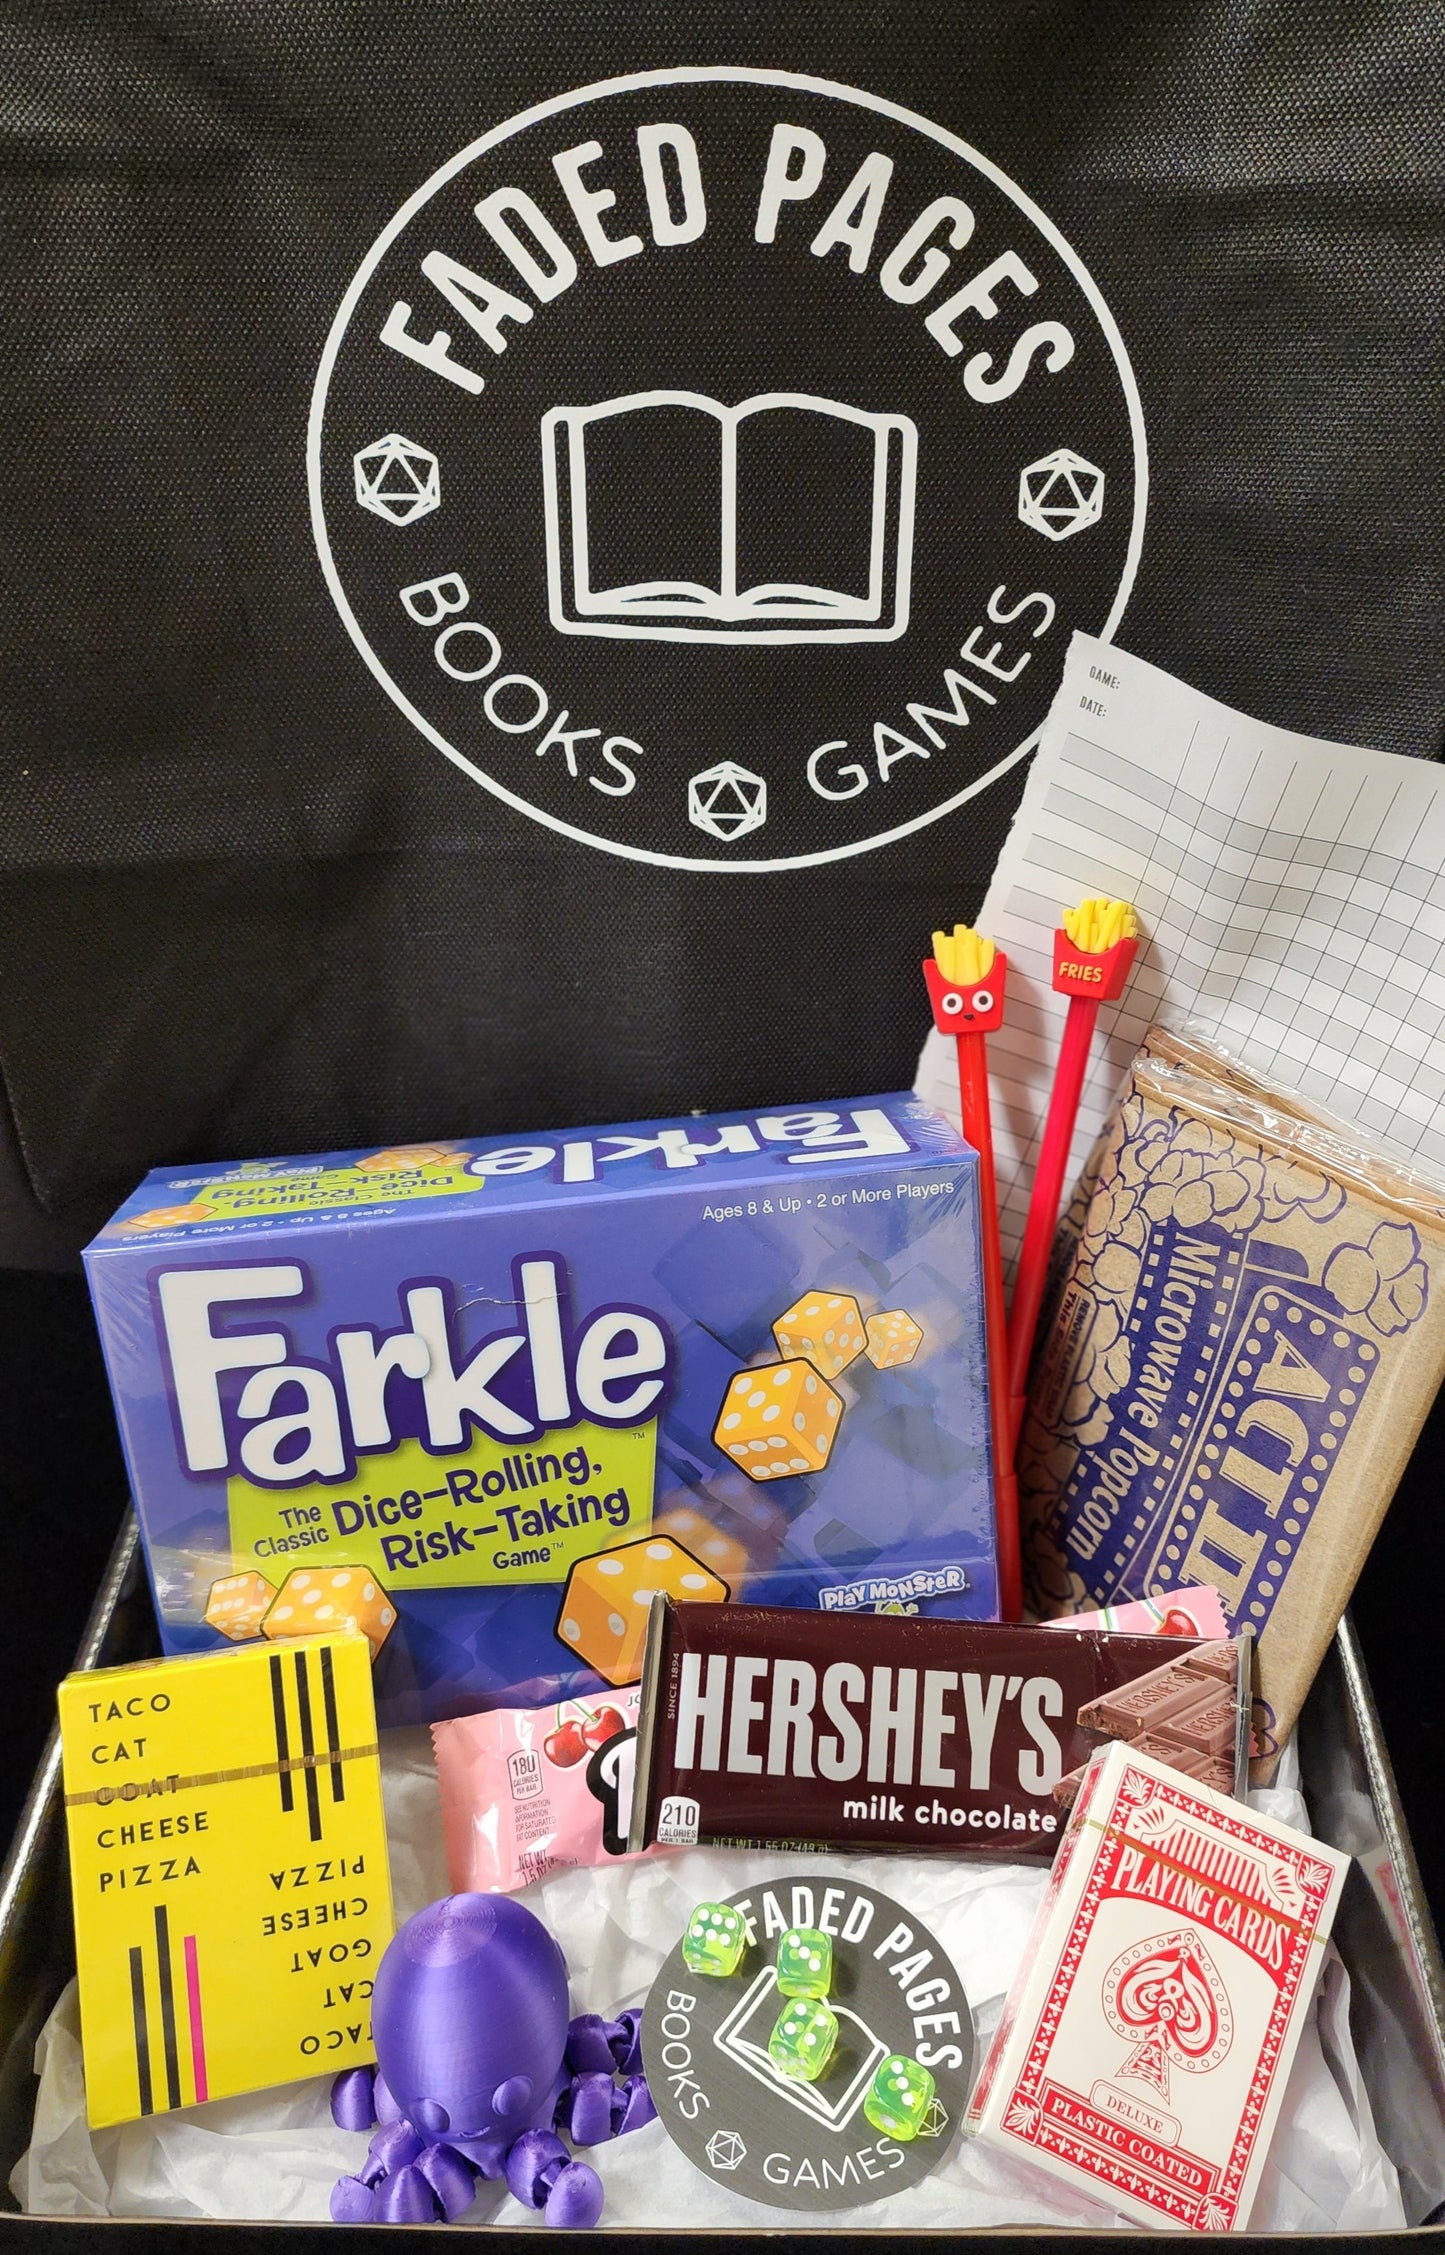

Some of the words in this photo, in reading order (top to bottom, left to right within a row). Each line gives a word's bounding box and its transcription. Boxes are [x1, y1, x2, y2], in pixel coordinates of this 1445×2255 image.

[379, 122, 710, 396] FADED
[754, 122, 1076, 404] PAGES
[398, 571, 645, 797] BOOKS
[806, 583, 1057, 802] GAMES
[1088, 664, 1121, 690] GAME:
[1079, 695, 1108, 719] DATE:
[1058, 961, 1104, 984] FRIES
[468, 1108, 912, 1184] Farkle
[353, 1207, 397, 1219] Ages
[702, 1203, 743, 1222] Ages
[747, 1200, 758, 1216] 8
[763, 1199, 775, 1215] &
[779, 1197, 803, 1216] Up
[817, 1193, 828, 1209] 2
[831, 1194, 848, 1208] or
[851, 1184, 892, 1204] More
[895, 1179, 955, 1202] Players
[122, 1228, 188, 1243] Players
[190, 1223, 236, 1235] More
[239, 1221, 261, 1229] or
[291, 1215, 315, 1225] Up
[1058, 1290, 1077, 1323] This
[1069, 1298, 1091, 1344] REMOVE
[1127, 1231, 1221, 1428] Microwave
[157, 1259, 668, 1481] Farkle
[1218, 1329, 1332, 1520] ACT
[1065, 1419, 1161, 1561] Popcorn
[278, 1508, 322, 1530] The
[380, 1487, 631, 1571] Risk-Taking
[252, 1526, 330, 1558] Classic
[670, 1652, 681, 1681] 1894
[88, 1692, 172, 1724] TACO
[667, 1681, 678, 1720] SINCE
[674, 1651, 1064, 1797] HERSHEY'S
[91, 1737, 147, 1765] CAT
[511, 1754, 536, 1777] 180
[96, 1811, 210, 1849] CHEESE
[658, 1827, 697, 1839] CALORIES
[661, 1803, 697, 1827] 210
[842, 1795, 904, 1823] milk
[913, 1797, 1059, 1835] chocolate
[99, 1855, 202, 1893] PIZZA
[269, 1854, 365, 1891] PIZZA
[518, 1852, 534, 1871] NET
[262, 1897, 368, 1936] CHEESE
[1111, 1851, 1212, 1921] PLAYING
[1212, 1890, 1291, 1972] CARDS
[290, 1938, 372, 1973] GOAT
[323, 1980, 375, 2008] CAT
[732, 1886, 876, 1948] FADED
[872, 1921, 963, 2070] PAGES
[661, 1989, 711, 2121] BOOKS
[1105, 2094, 1165, 2135] DELUXE
[1050, 2097, 1126, 2147] PLASTIC
[1127, 2135, 1203, 2188] COATED
[762, 2136, 906, 2190] GAMES
